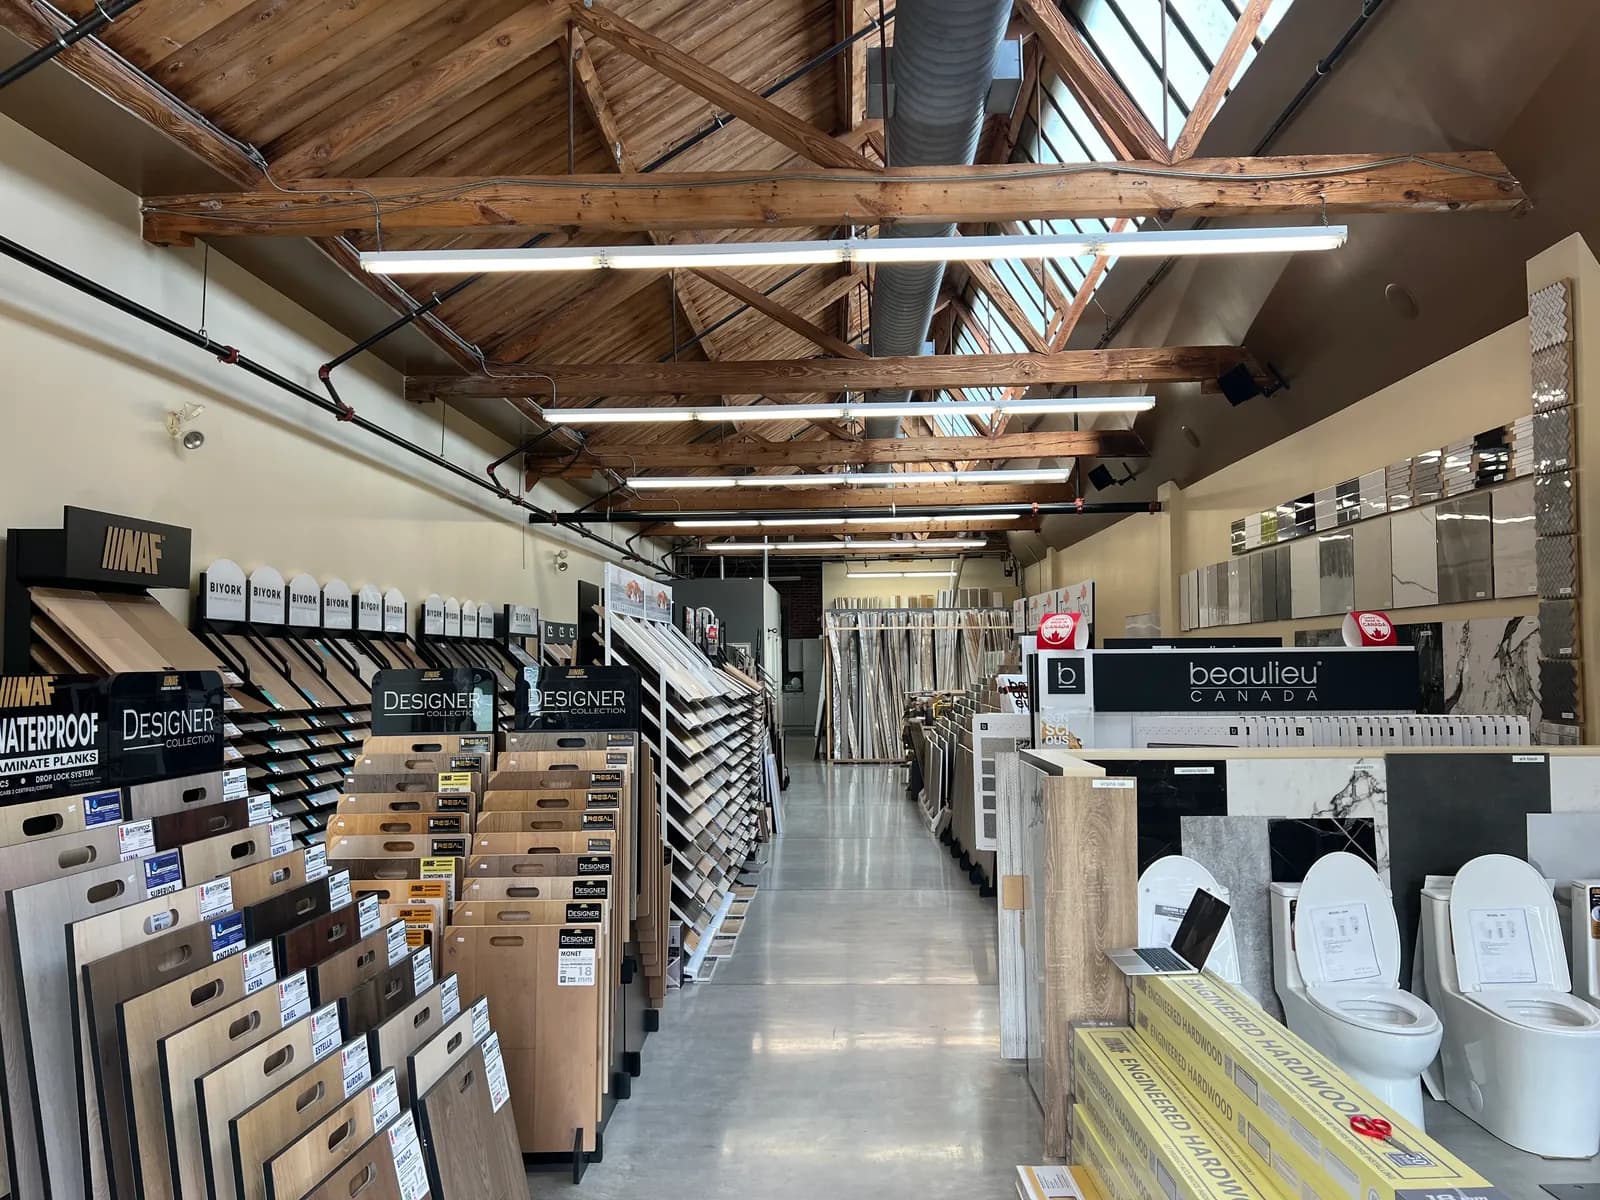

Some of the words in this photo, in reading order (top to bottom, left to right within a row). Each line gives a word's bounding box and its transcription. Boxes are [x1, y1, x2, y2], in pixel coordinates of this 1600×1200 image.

[210, 581, 242, 596] BIYORK
[253, 586, 281, 600] BIYORK
[292, 593, 318, 605] BIYORK
[326, 597, 349, 609] BIYORK
[361, 601, 380, 611] BIYORK
[386, 604, 403, 614] BIYORK
[1058, 661, 1077, 685] b
[1189, 661, 1317, 685] beaulieu
[384, 690, 480, 710] DESIGNER
[528, 688, 625, 707] DESIGNER
[1190, 690, 1318, 703] CANADA
[123, 708, 214, 740] DESIGNER
[166, 734, 215, 748] COLLECTION
[53, 752, 97, 766] PLANKS
[35, 774, 53, 783] DROP
[53, 772, 70, 781] LOCK
[70, 769, 94, 779] SYSTEM
[577, 966, 592, 977] 18
[247, 978, 264, 992] ASTRA
[1184, 978, 1266, 1038] ENGINEERED
[283, 1009, 297, 1023] ARIEL
[315, 1038, 333, 1056] ESTELLA
[1182, 1018, 1222, 1067] HARDWOOD
[1150, 1024, 1187, 1071] ENGINEERED
[1187, 1061, 1233, 1121] HARDWOOD
[1120, 1058, 1191, 1131] ENGINEERED
